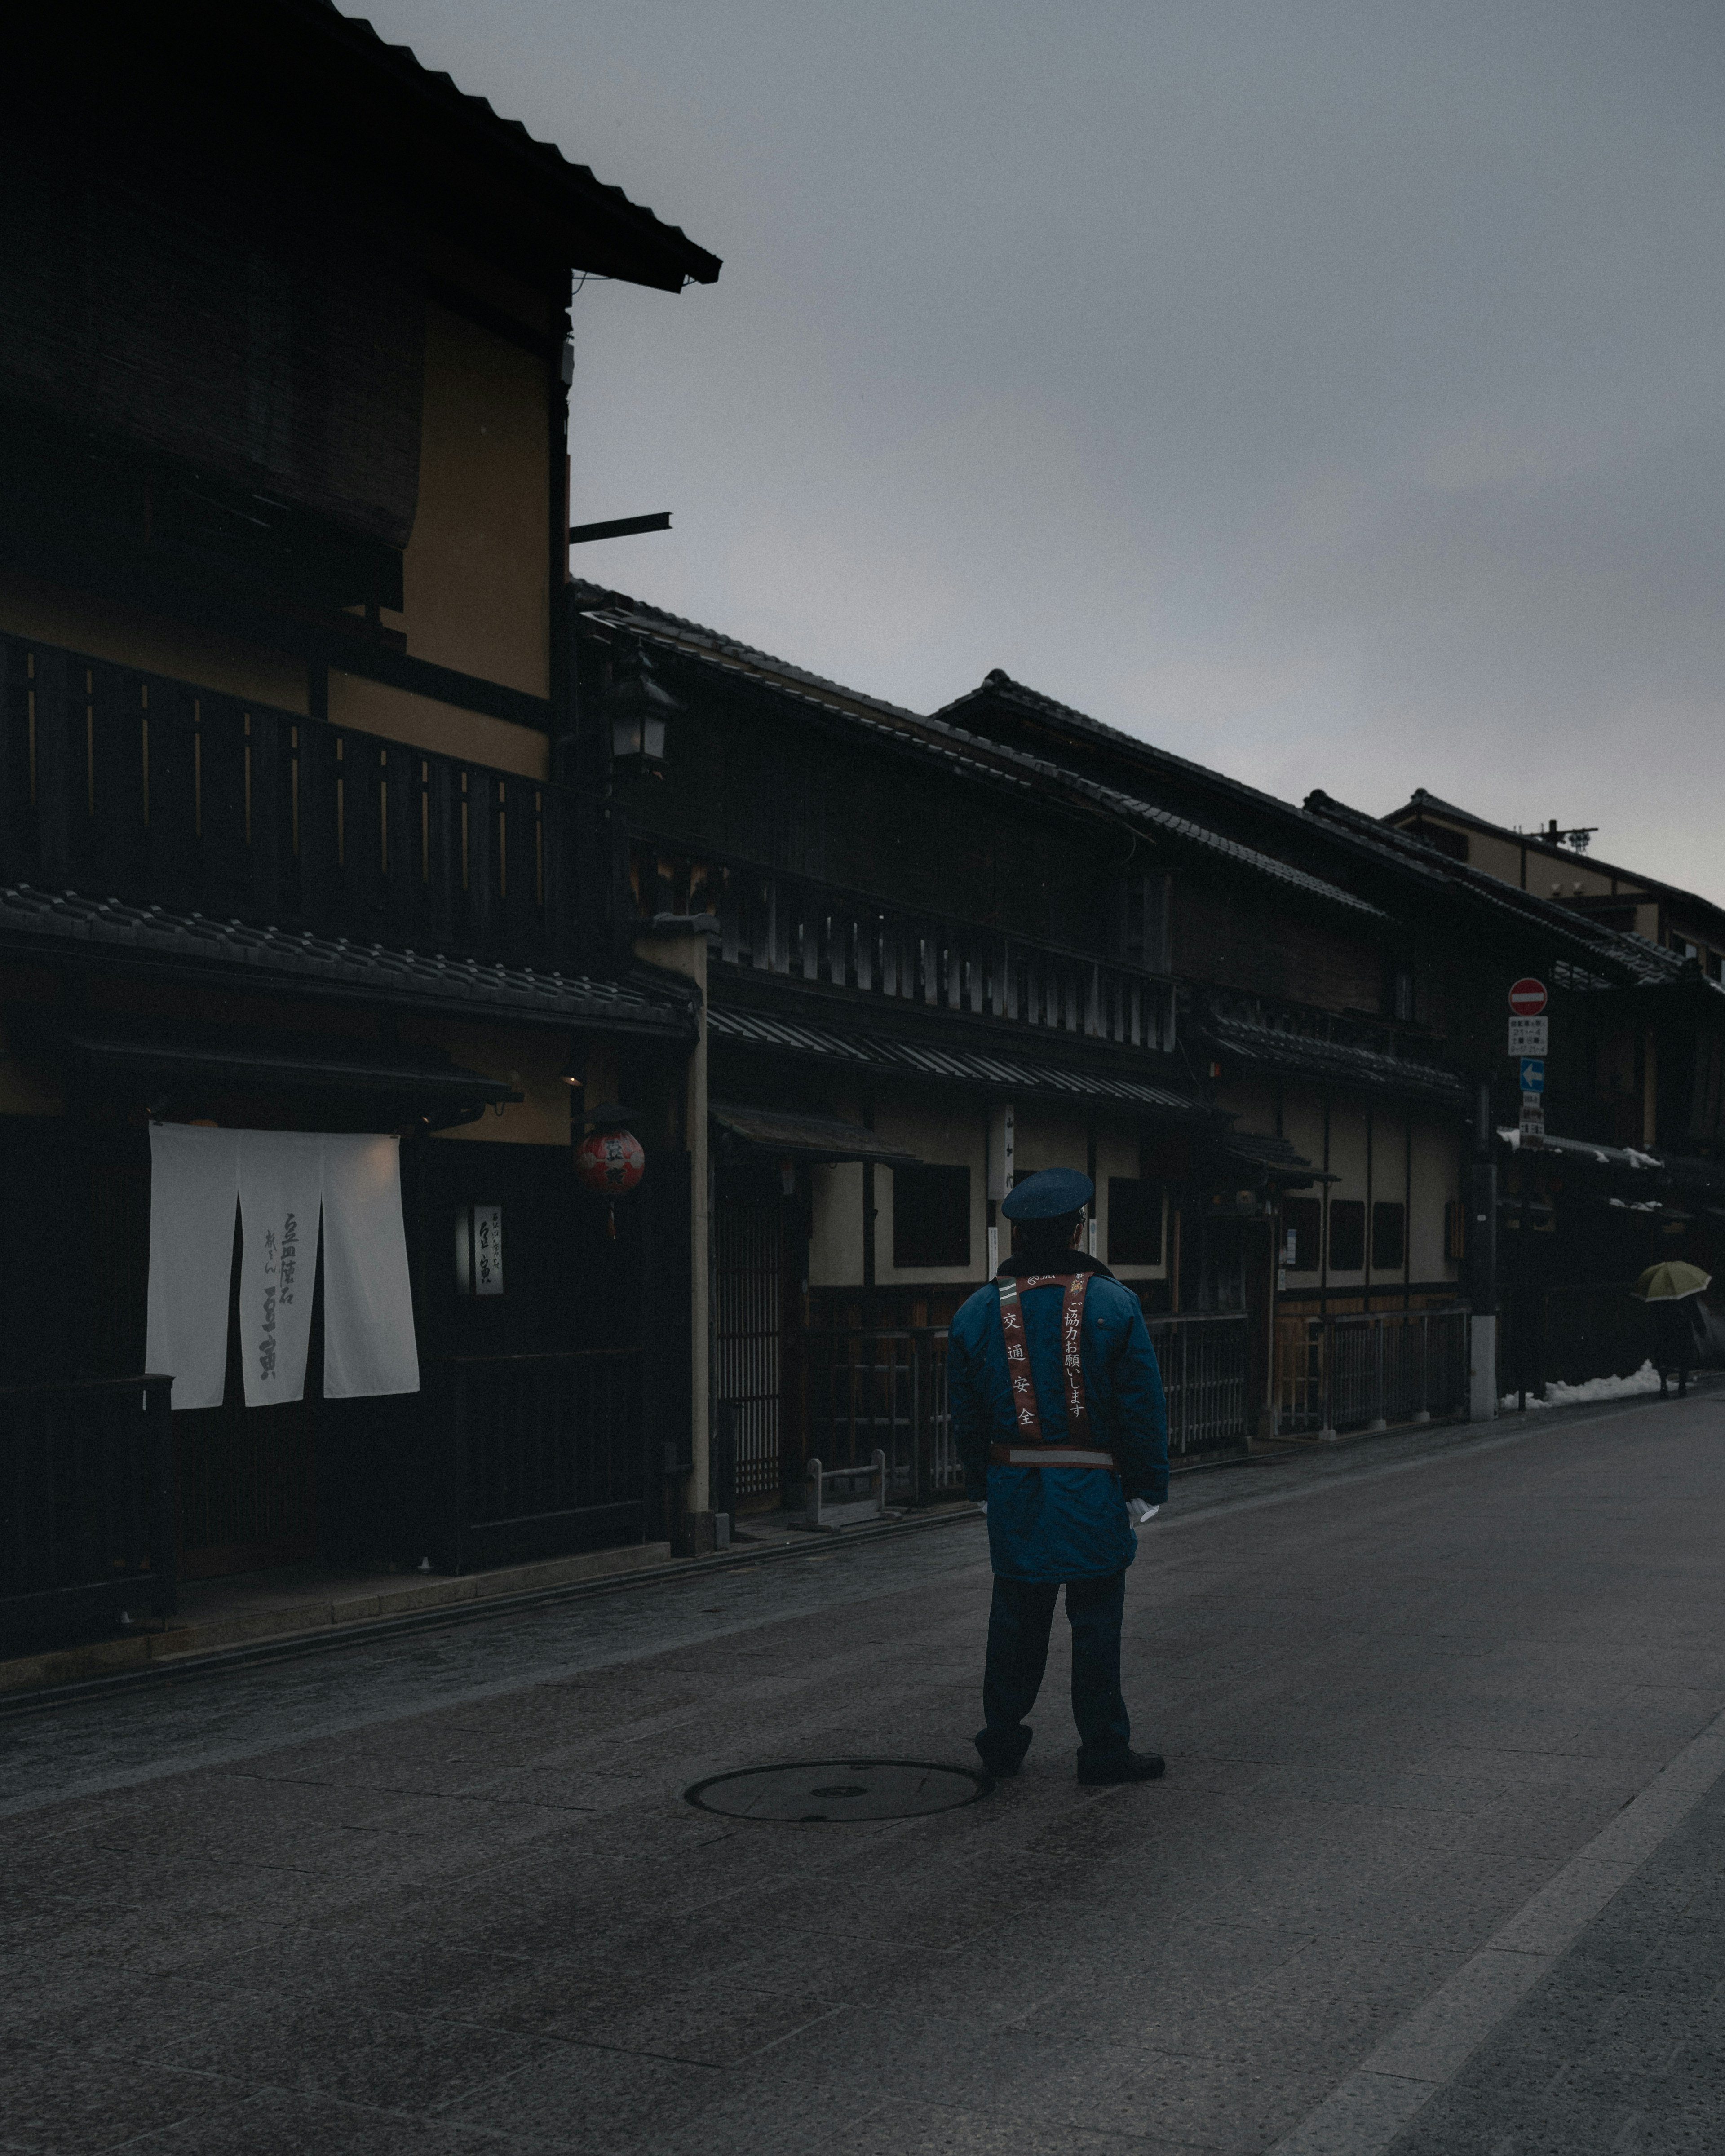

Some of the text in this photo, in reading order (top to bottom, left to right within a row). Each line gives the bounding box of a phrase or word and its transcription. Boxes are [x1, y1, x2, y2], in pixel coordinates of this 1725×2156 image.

[480, 1221, 491, 1284] 豆寅
[1004, 1313, 1035, 1425] 交通安全
[1064, 1302, 1084, 1418] ご協力お願いします
